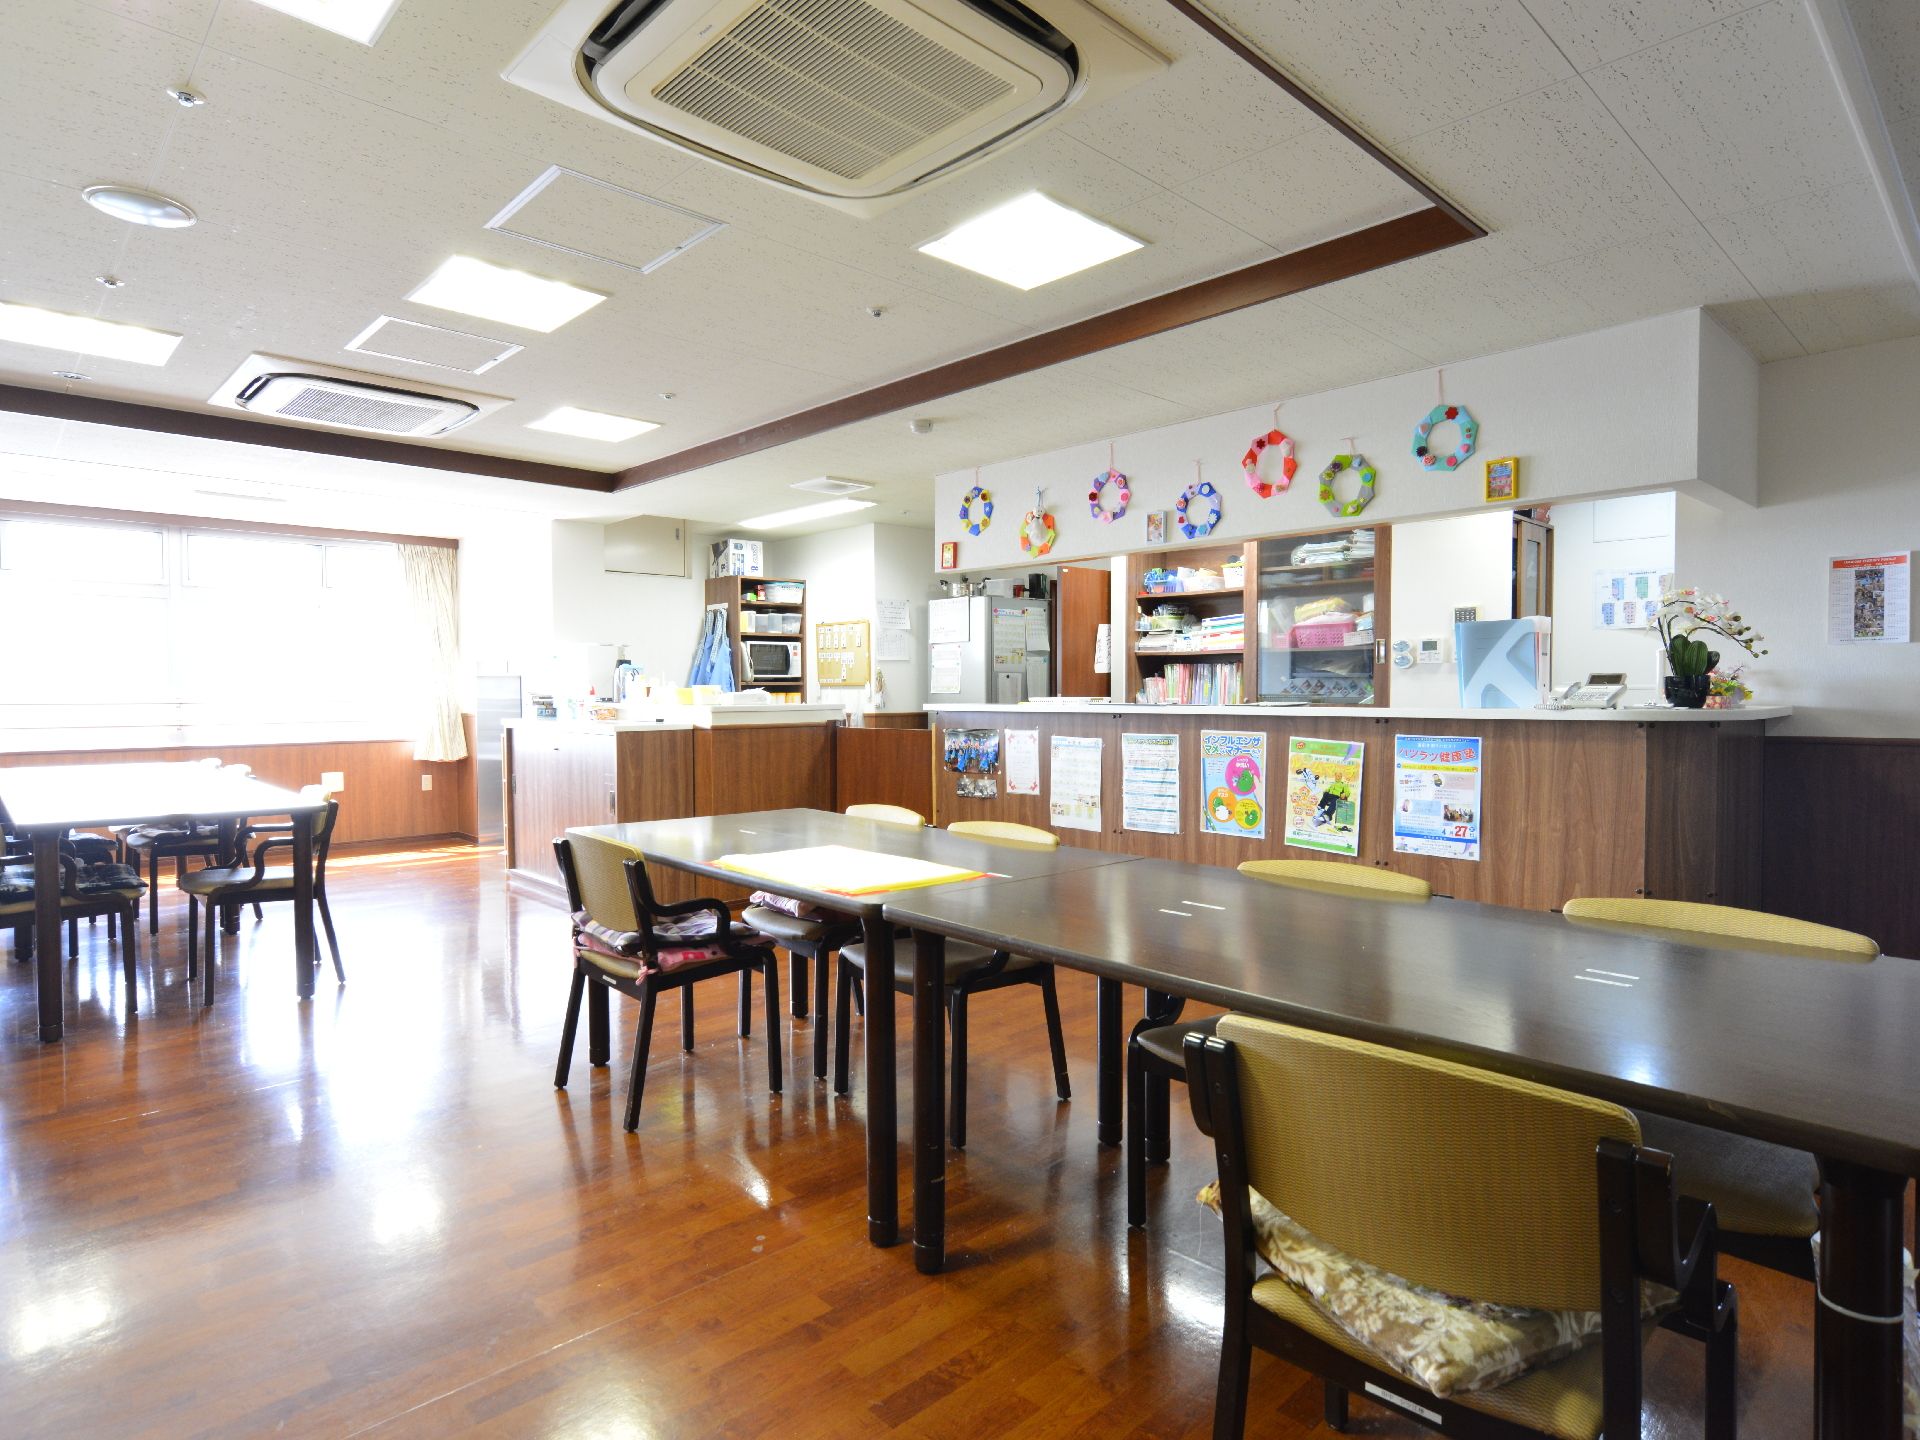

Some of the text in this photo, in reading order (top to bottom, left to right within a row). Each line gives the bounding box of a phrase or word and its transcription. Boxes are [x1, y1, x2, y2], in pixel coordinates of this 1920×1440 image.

[1204, 735, 1261, 746] インフルエンザ
[1454, 825, 1469, 838] 27
